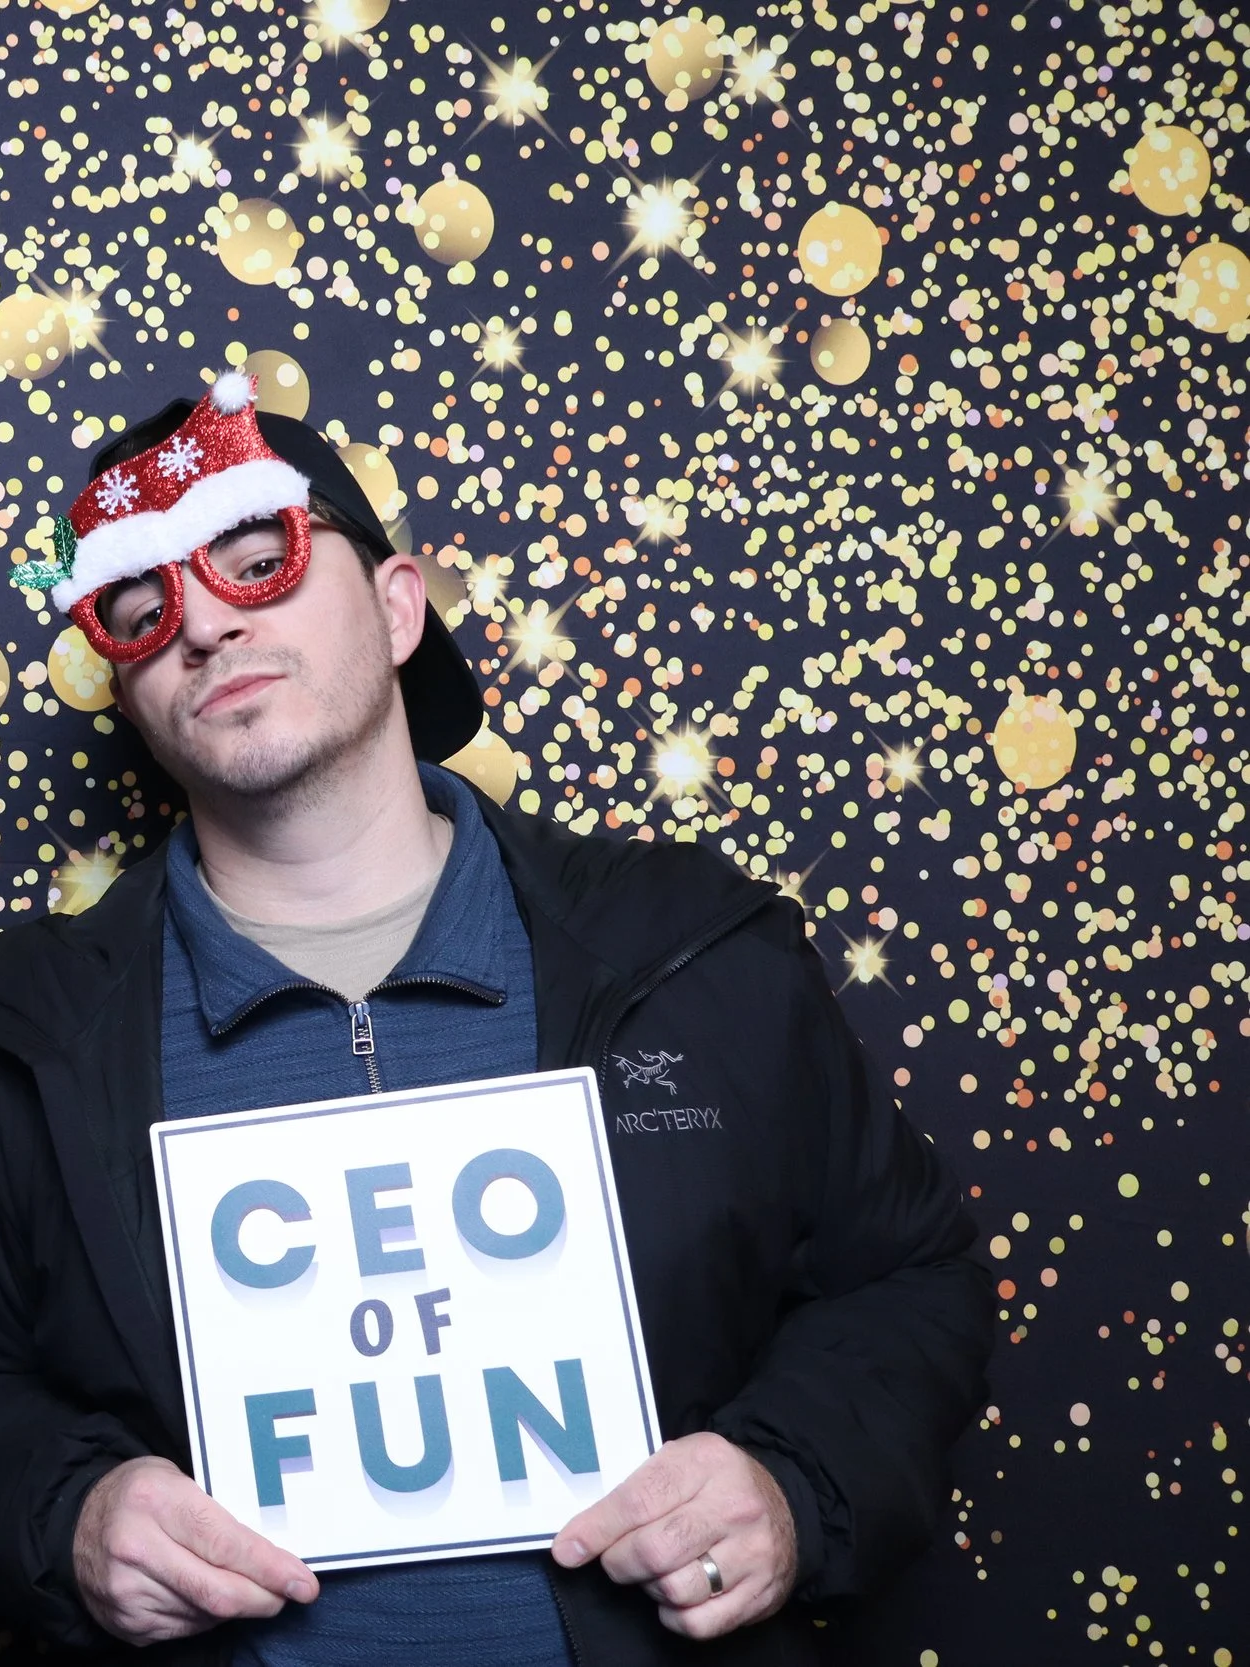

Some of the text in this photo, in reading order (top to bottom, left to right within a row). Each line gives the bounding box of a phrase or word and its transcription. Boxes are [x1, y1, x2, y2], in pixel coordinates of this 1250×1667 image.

[616, 1107, 723, 1134] ARC'TERYX
[211, 1148, 566, 1290] CEO
[350, 1287, 452, 1357] OF
[244, 1358, 601, 1508] FUN
